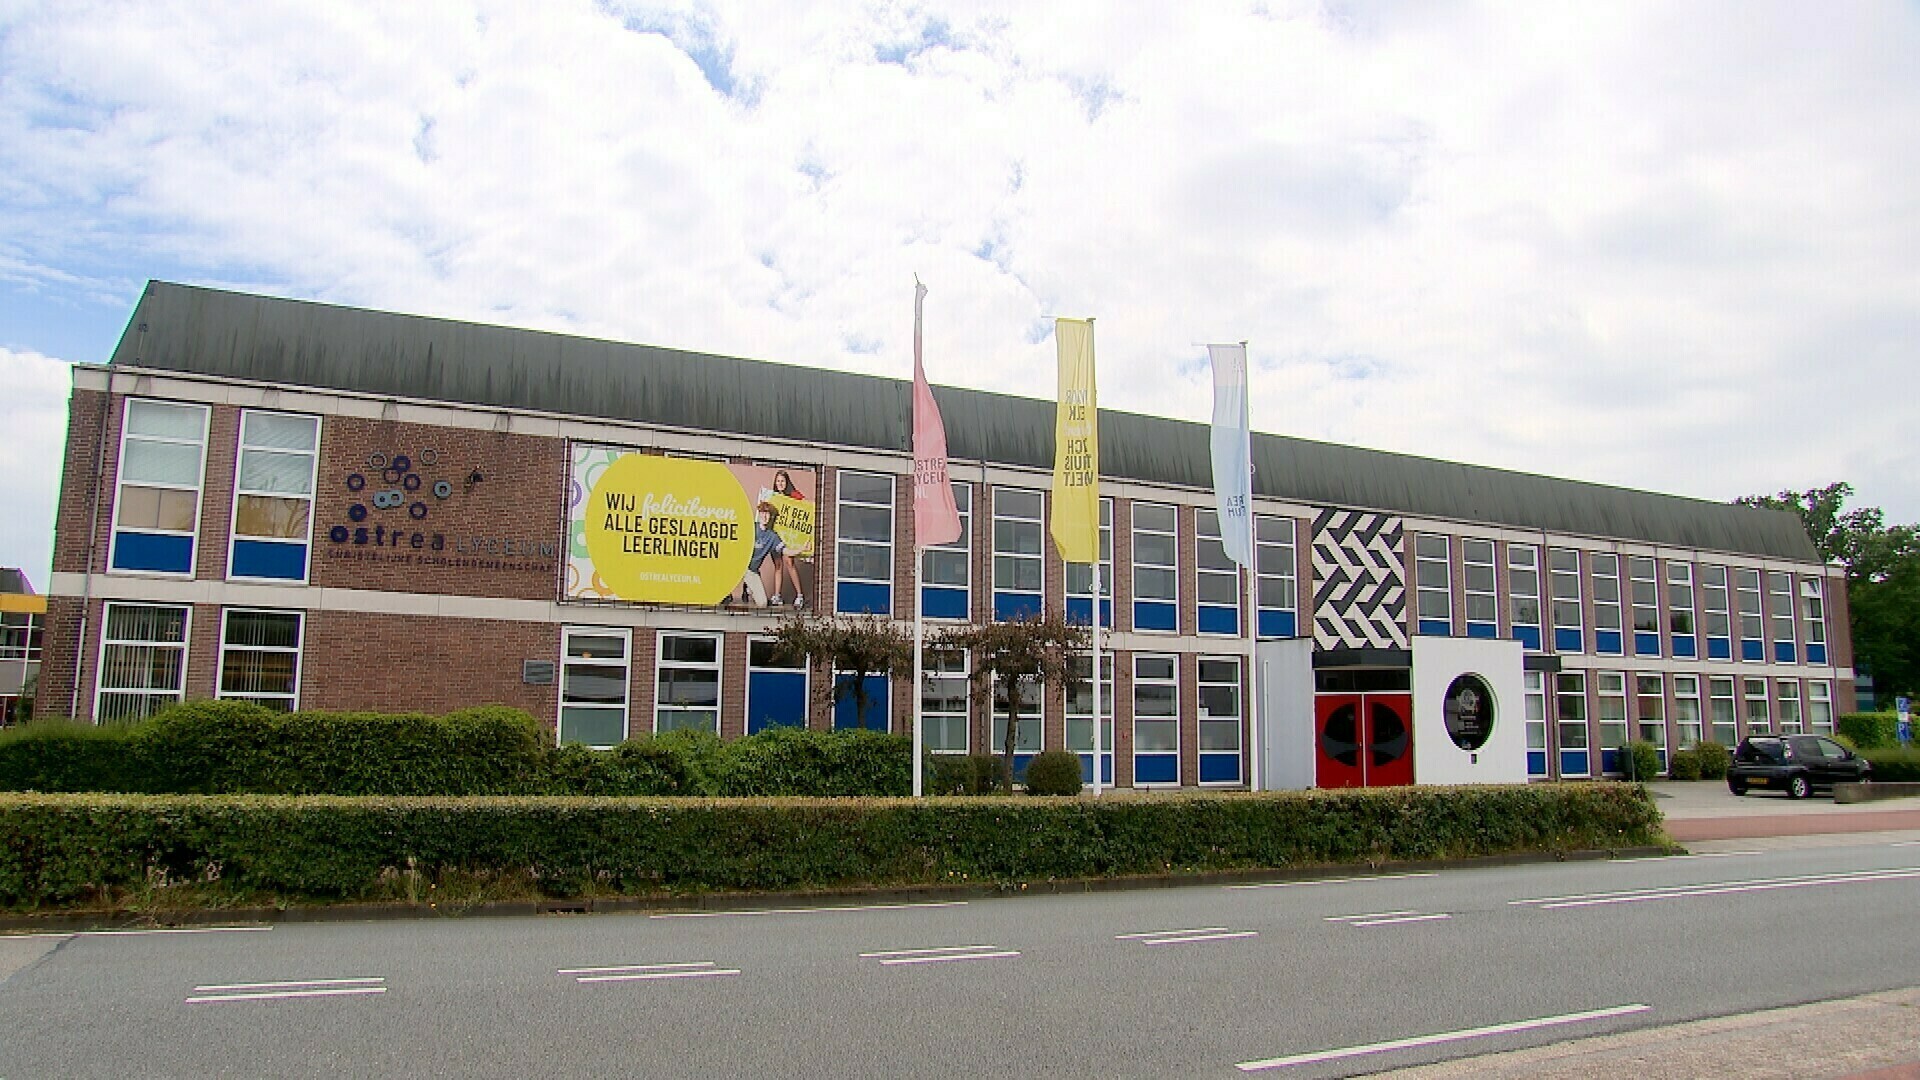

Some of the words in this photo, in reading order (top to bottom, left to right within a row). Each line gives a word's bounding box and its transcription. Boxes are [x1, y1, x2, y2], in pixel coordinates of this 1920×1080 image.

[606, 492, 635, 512] WIJ
[642, 491, 737, 521] feliciteren
[781, 504, 791, 515] IK
[791, 507, 810, 523] BEN
[330, 525, 444, 550] ostrea
[457, 536, 554, 557] LYCEUM
[604, 513, 643, 533] ALLE
[649, 517, 738, 541] GESLAAGDE
[623, 535, 719, 559] LEERLINGEN
